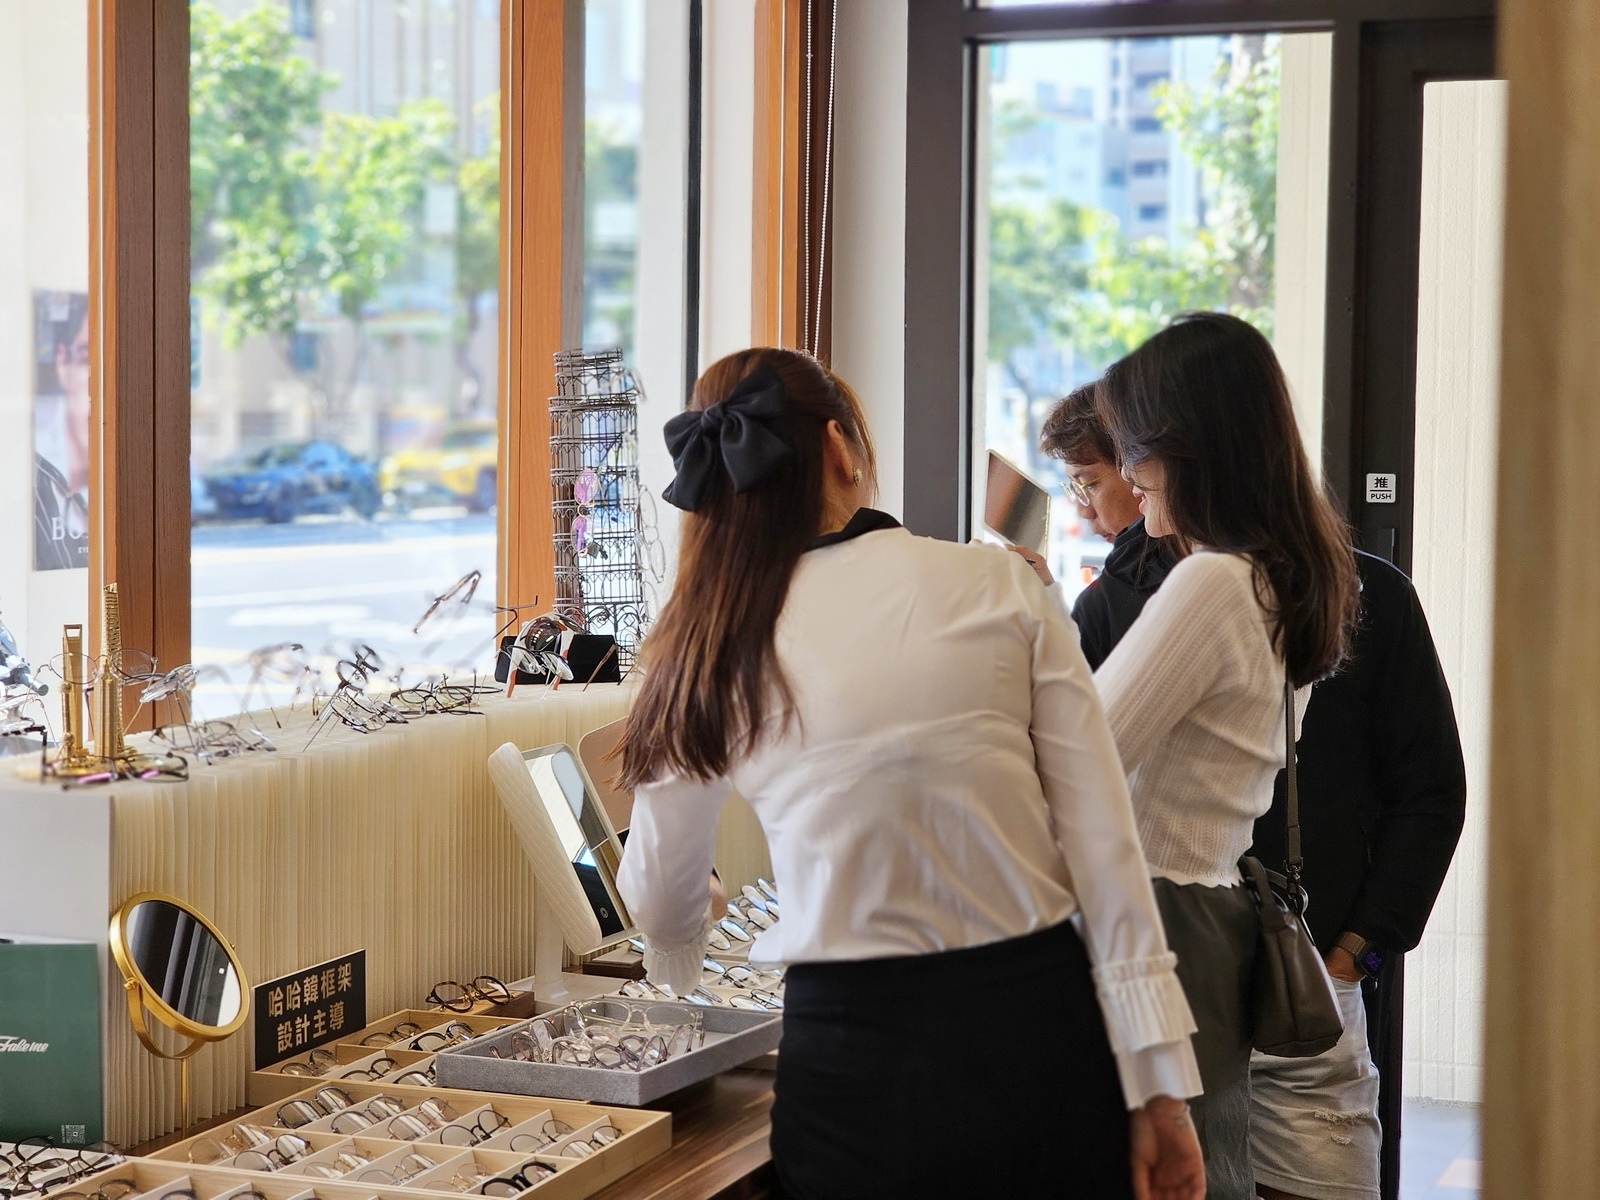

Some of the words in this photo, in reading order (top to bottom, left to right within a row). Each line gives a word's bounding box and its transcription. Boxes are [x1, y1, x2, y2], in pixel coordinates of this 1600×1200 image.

[1374, 476, 1388, 488] 推
[268, 962, 352, 1018] 哈哈韓框架
[277, 1001, 345, 1054] 設計主導
